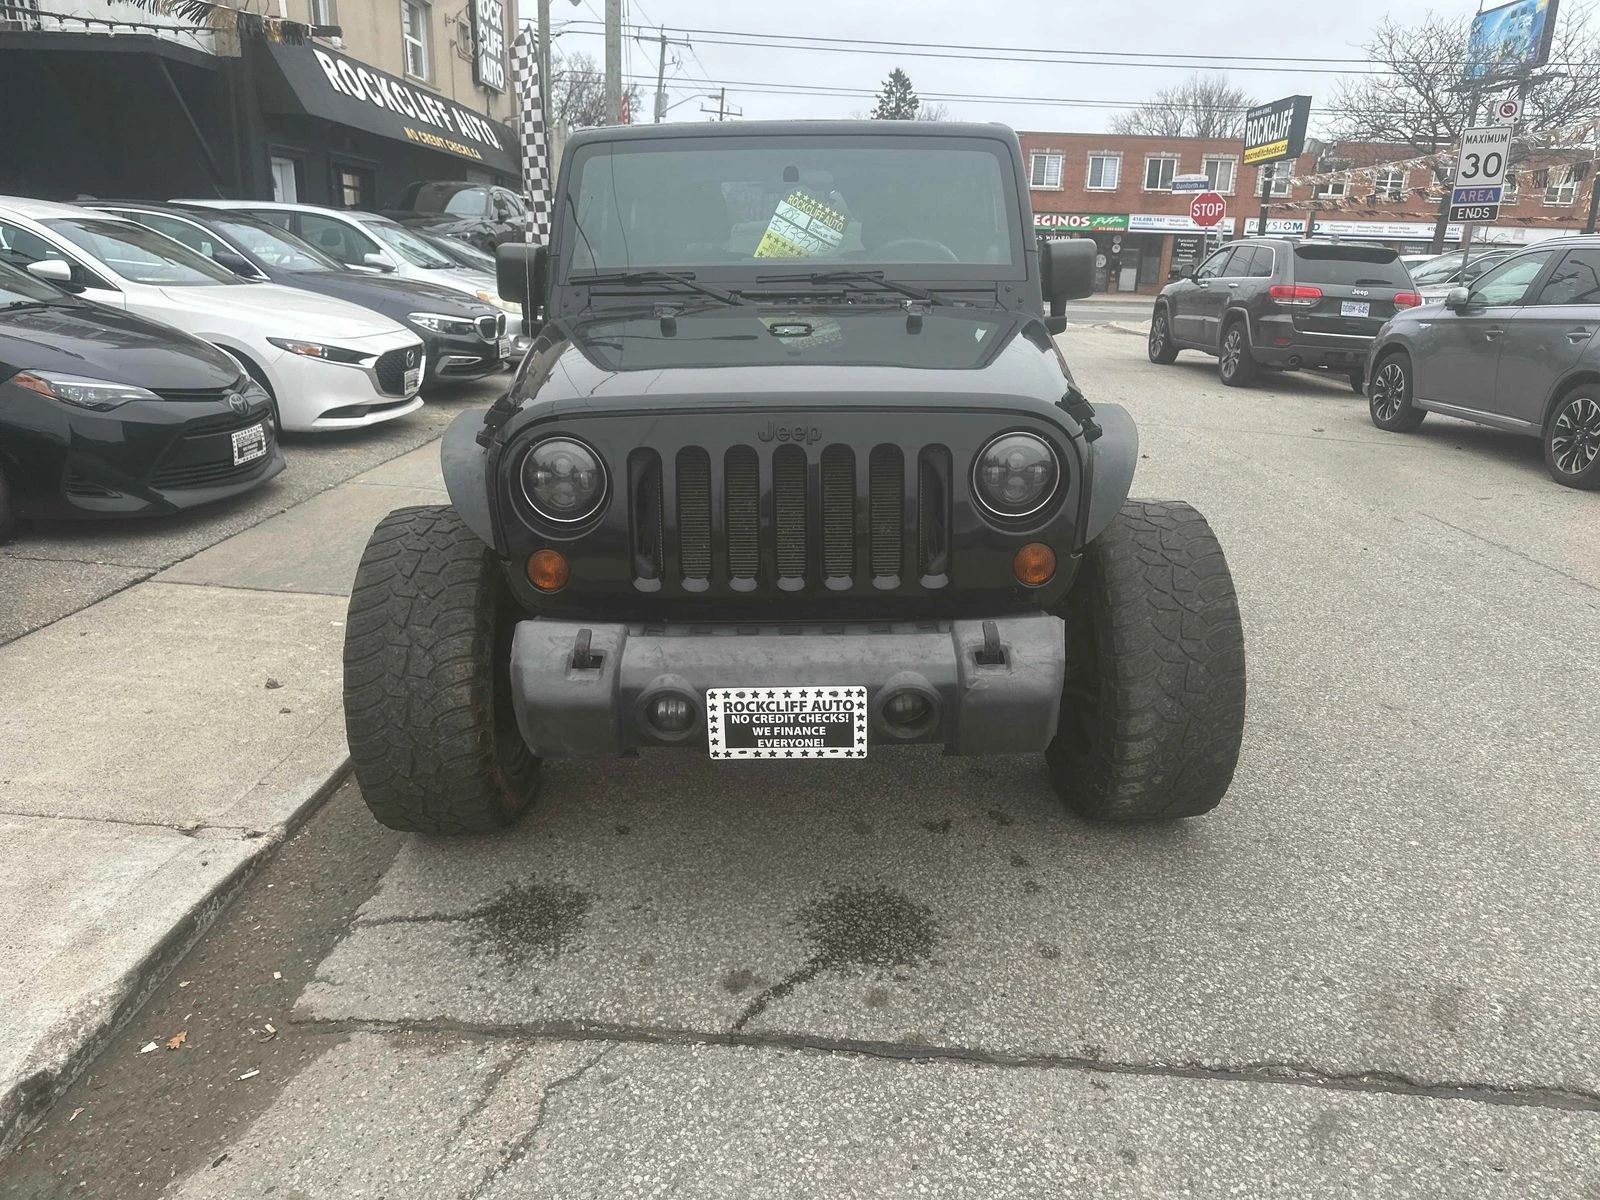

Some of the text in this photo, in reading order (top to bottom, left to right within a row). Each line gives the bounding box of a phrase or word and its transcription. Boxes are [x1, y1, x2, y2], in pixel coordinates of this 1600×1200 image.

[482, 55, 504, 88] AUTO
[313, 48, 453, 132] ROCKCLIFF
[1245, 108, 1294, 147] ROCKCLIFF
[418, 131, 447, 149] CREDIT
[1465, 133, 1508, 145] MAXIMUM
[1462, 152, 1502, 179] 30
[1457, 190, 1496, 202] AREA
[787, 194, 826, 221] ROCKCLIFF
[824, 214, 844, 232] AUTO
[1193, 203, 1224, 218] STOP
[1457, 207, 1490, 219] ENDS
[1033, 214, 1090, 227] EGINOS
[1352, 289, 1369, 297] Jeep
[757, 420, 822, 445] Jeep
[724, 699, 855, 713] ROCKCLIFF AUTO
[731, 713, 850, 724] NO CREDIT CHECKS!
[752, 726, 826, 736] WE FINANCE
[757, 738, 825, 748] EVERYONE!
